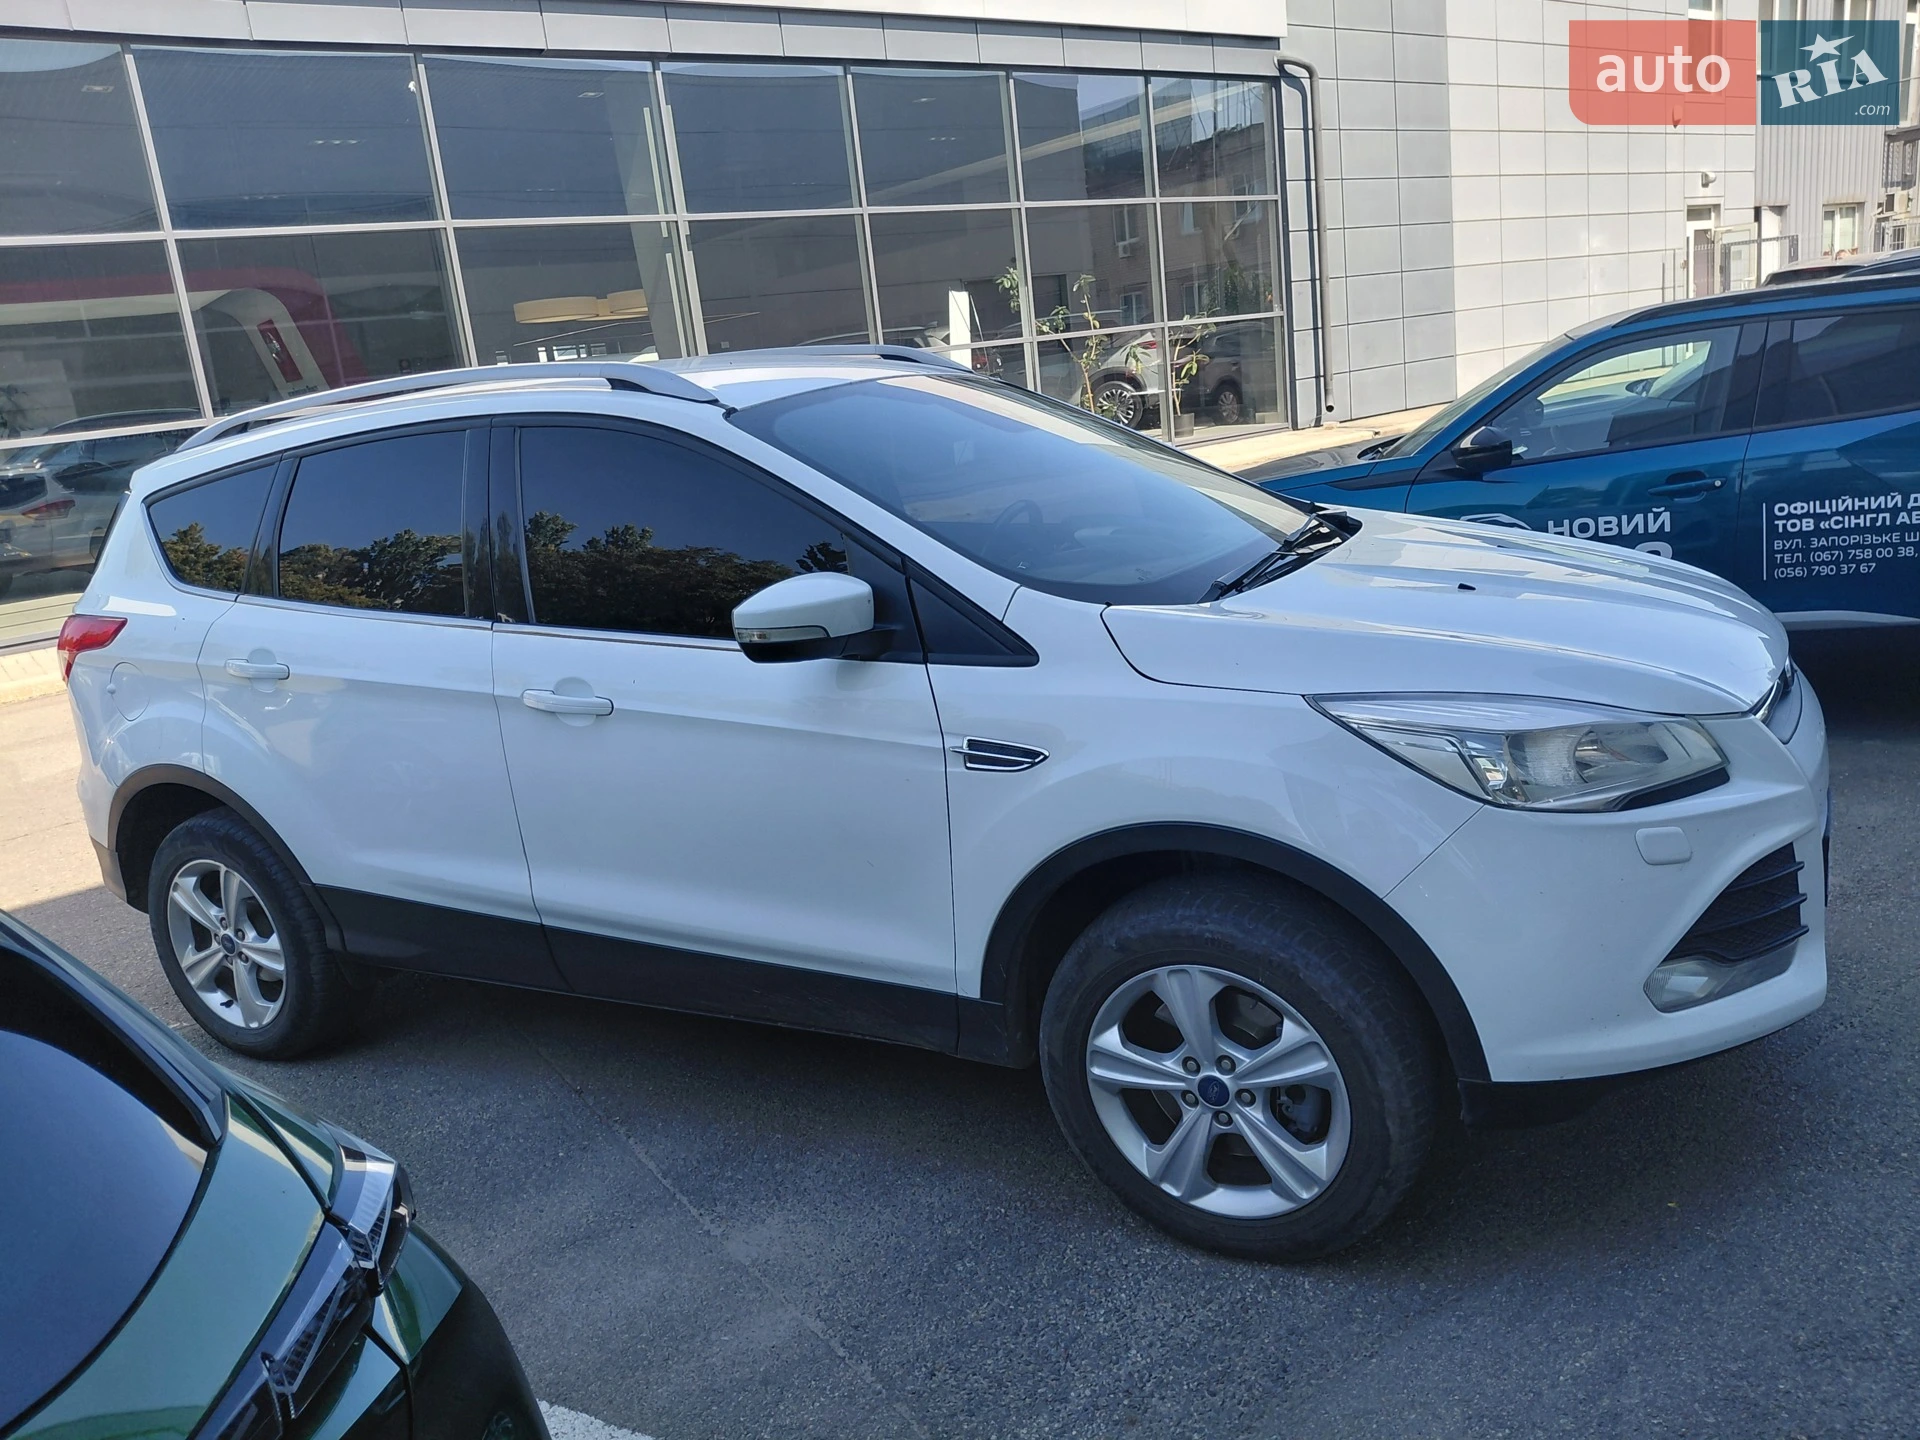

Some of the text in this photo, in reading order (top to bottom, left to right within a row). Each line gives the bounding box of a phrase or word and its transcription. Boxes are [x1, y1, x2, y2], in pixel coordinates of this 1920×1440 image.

[1774, 492, 1902, 516] ОФІЦІЙНИЙ
[1547, 507, 1672, 539] НОВИЙ
[1774, 518, 1814, 533] ТОВ
[1819, 512, 1890, 529] «СІНГЛ
[1774, 539, 1806, 550] ВУЛ.
[1810, 532, 1901, 548] ЗАПОРІЗЬКЕ
[1774, 546, 1918, 564] ТЕЛ. (067) 758 00 38,
[1774, 562, 1876, 579] (056) 790 37 67
